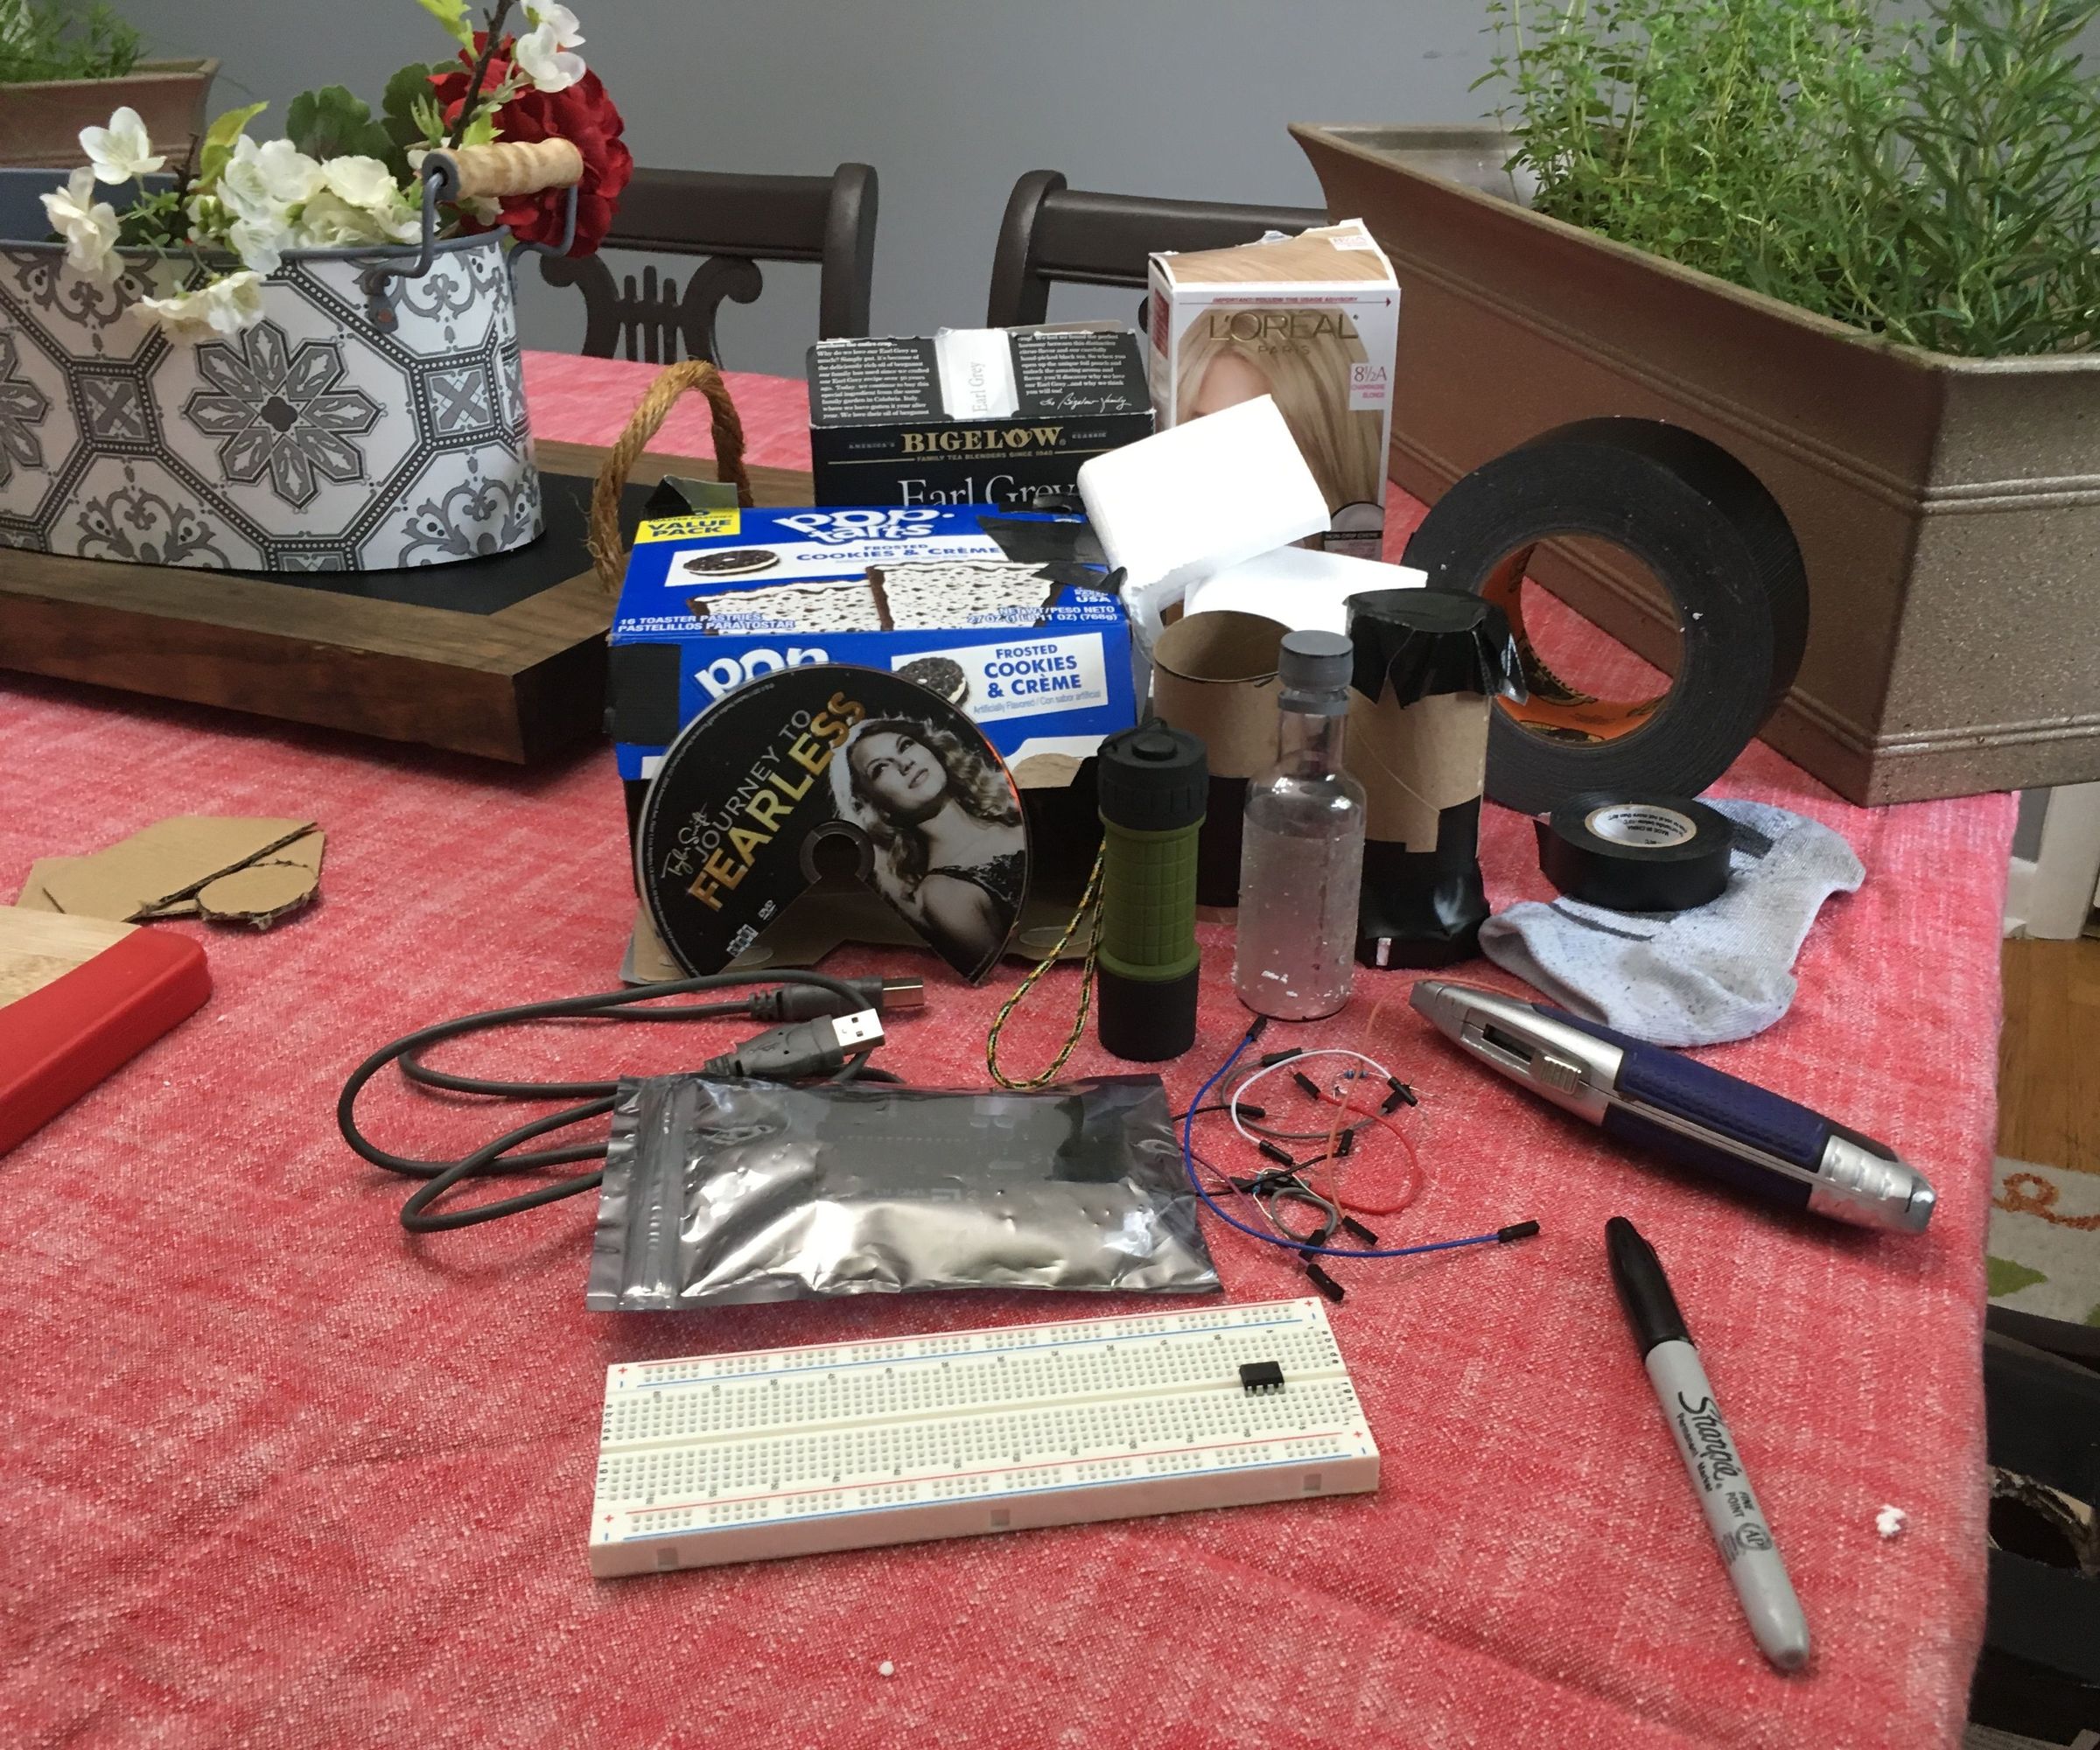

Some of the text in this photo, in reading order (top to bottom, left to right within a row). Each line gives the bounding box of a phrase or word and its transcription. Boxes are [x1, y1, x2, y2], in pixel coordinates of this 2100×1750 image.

[1258, 345, 1311, 355] PARIS
[901, 426, 1064, 453] BIGELOW
[648, 519, 732, 531] VALUE
[652, 527, 723, 537] PACK
[808, 522, 934, 543] tarts
[796, 550, 895, 561] COOKIES
[618, 622, 703, 634] PASTELILLOS
[640, 615, 696, 625] TOASTER
[996, 644, 1059, 660] FROSTED
[984, 654, 1078, 679] COOKIES
[987, 673, 1082, 699] & CRÈME
[697, 743, 781, 864] JOURNEY
[779, 709, 814, 740] TO
[687, 690, 867, 913] FEARLESS
[1676, 1390, 1740, 1480] Sharpie
[1676, 1411, 1713, 1492] Permanent Marker
[1725, 1492, 1746, 1518] POINT
[1738, 1490, 1755, 1512] FINE
